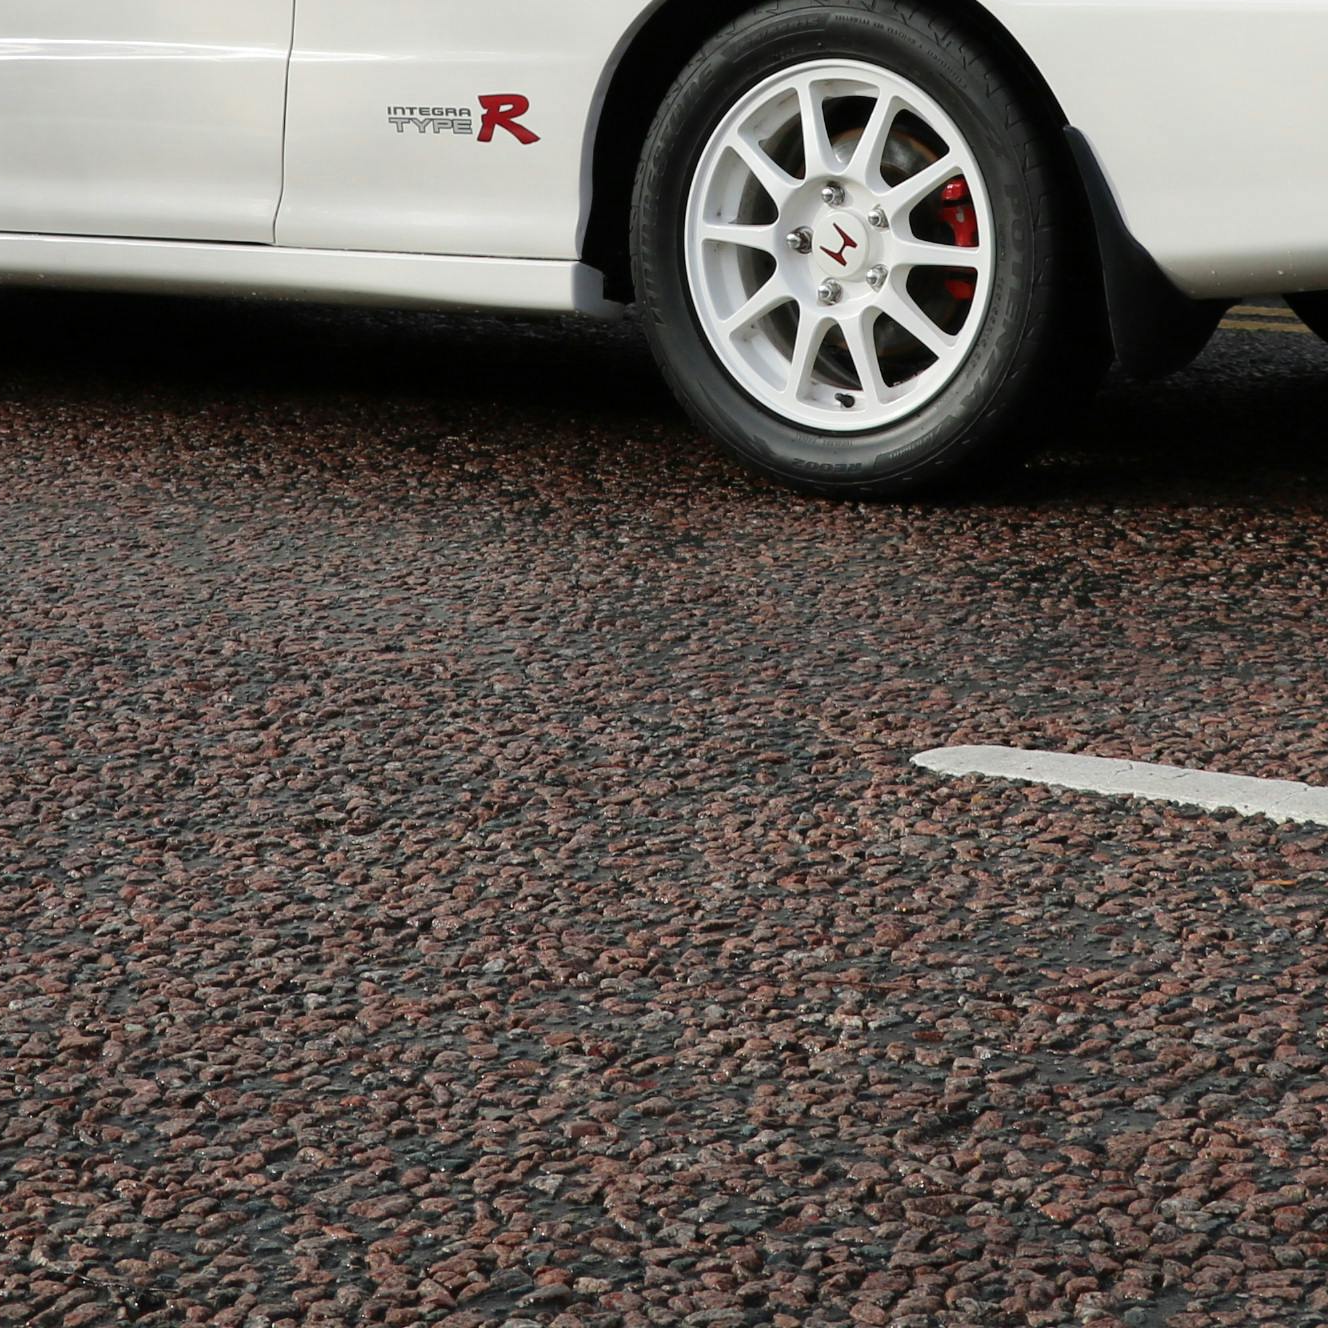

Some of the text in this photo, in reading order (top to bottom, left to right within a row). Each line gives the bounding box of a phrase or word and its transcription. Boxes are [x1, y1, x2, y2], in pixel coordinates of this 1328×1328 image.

[387, 105, 472, 117] INTEGRA
[388, 93, 541, 145] TYPE R
